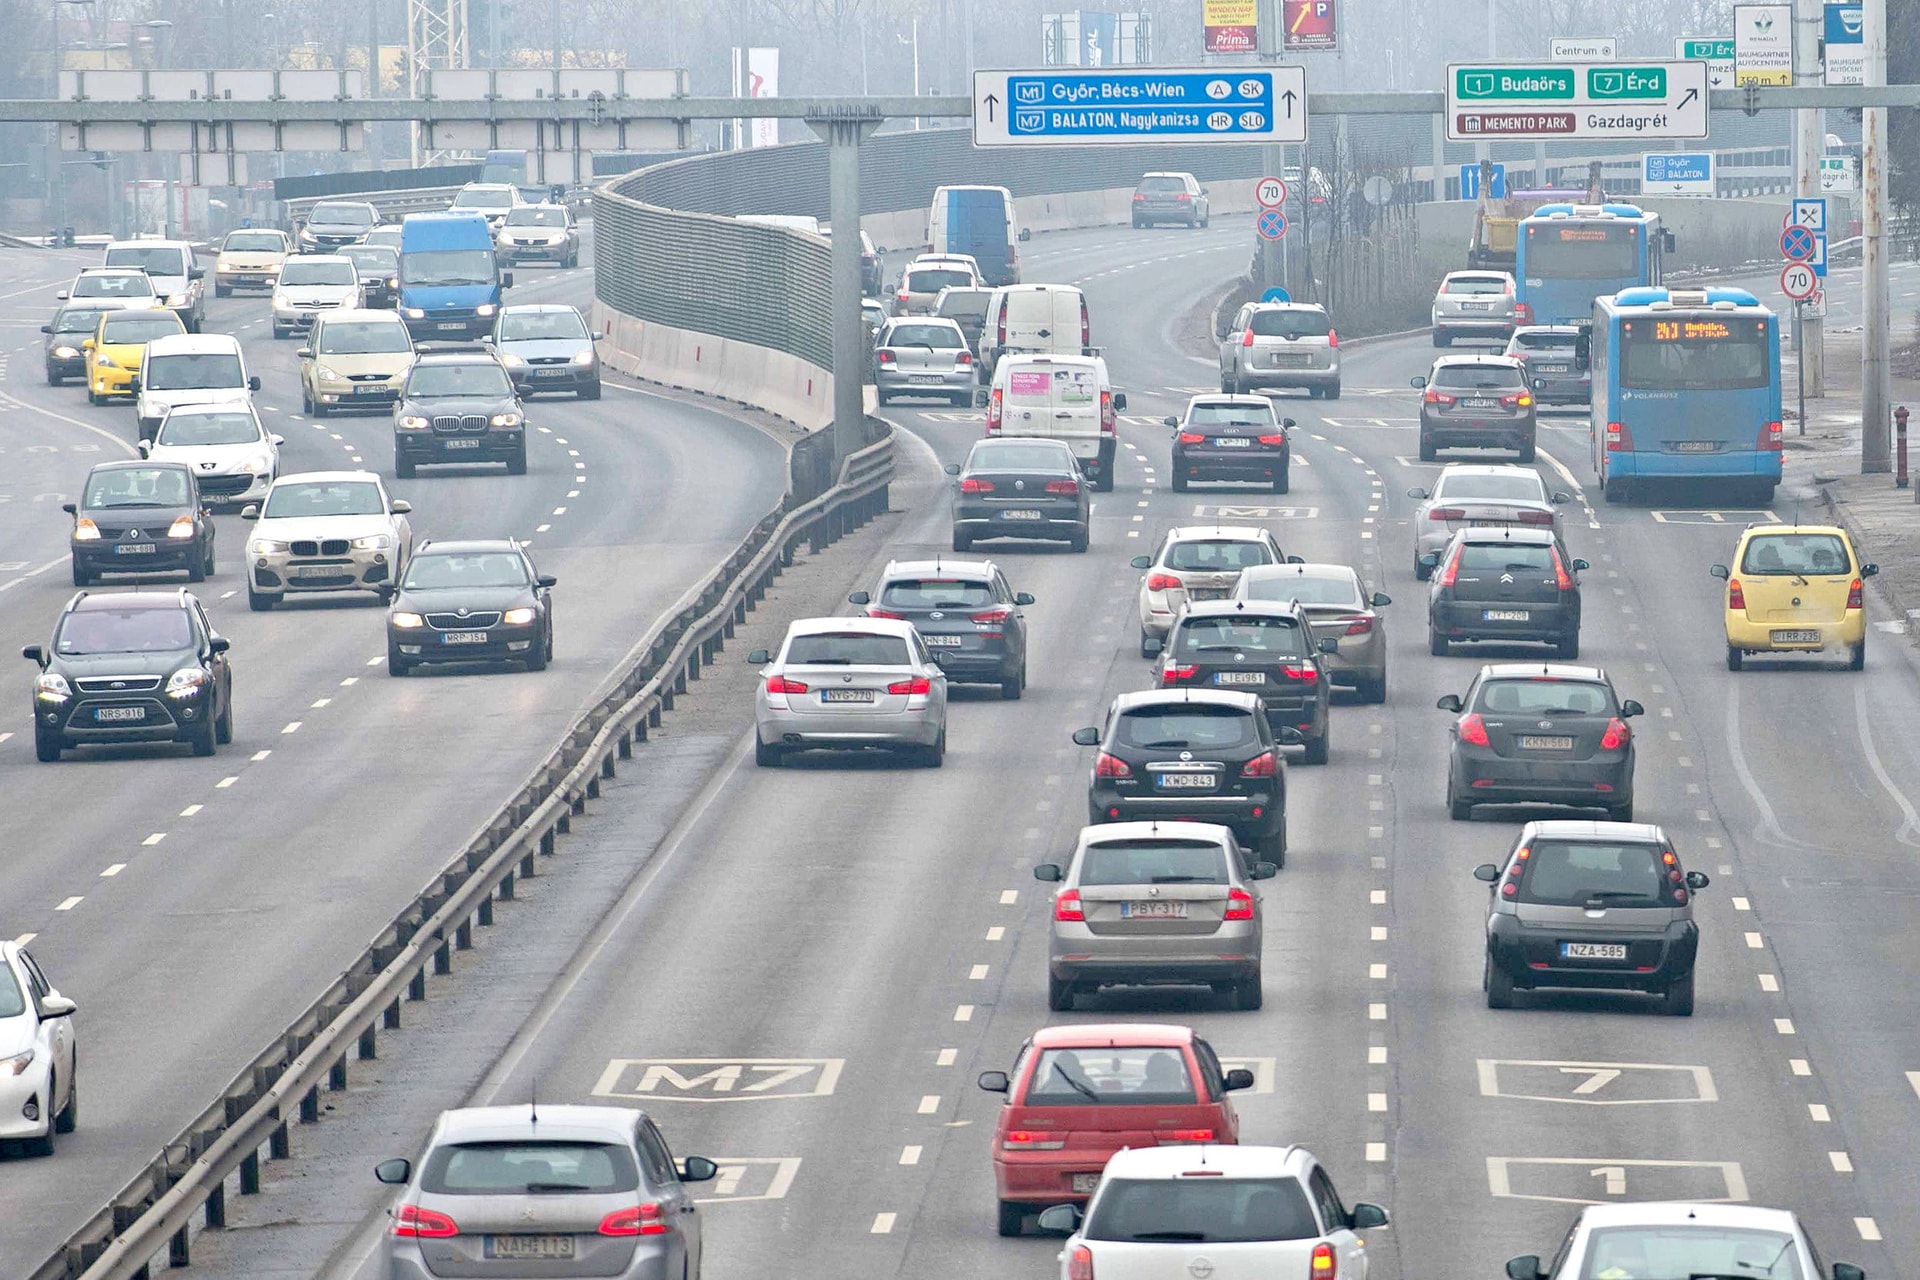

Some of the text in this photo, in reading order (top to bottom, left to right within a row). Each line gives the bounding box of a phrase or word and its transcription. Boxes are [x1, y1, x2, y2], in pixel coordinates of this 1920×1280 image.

[1316, 2, 1327, 16] P
[1216, 34, 1249, 45] Prima
[1555, 46, 1597, 56] Centrum
[1475, 72, 1659, 92] 1 Budaörs 7 Érd
[1021, 88, 1040, 100] M1
[1102, 80, 1185, 98] Bécs-Wien
[1212, 84, 1224, 96] A
[1242, 83, 1260, 96] SK
[1020, 111, 1263, 130] M7 BALATON, Nagykanizsa HR SLO
[1485, 116, 1568, 131] MEMENTO PARK
[1587, 113, 1668, 131] Gazdagrét
[1668, 158, 1691, 168] Győr
[1668, 170, 1703, 179] BALATON
[1822, 173, 1848, 182] dagrét
[1263, 186, 1279, 199] 70
[1789, 273, 1808, 289] 70
[924, 635, 961, 646] HN-844
[1781, 631, 1819, 642] IRR-235
[828, 690, 873, 701] NYG-770
[100, 707, 145, 719] NRS-916
[1164, 775, 1213, 787] KWD-843
[1130, 902, 1184, 914] PBY-317
[1569, 944, 1624, 958] NZA-585
[635, 1065, 816, 1092] M7
[1559, 1067, 1622, 1094] 7
[1590, 1166, 1626, 1195] 1
